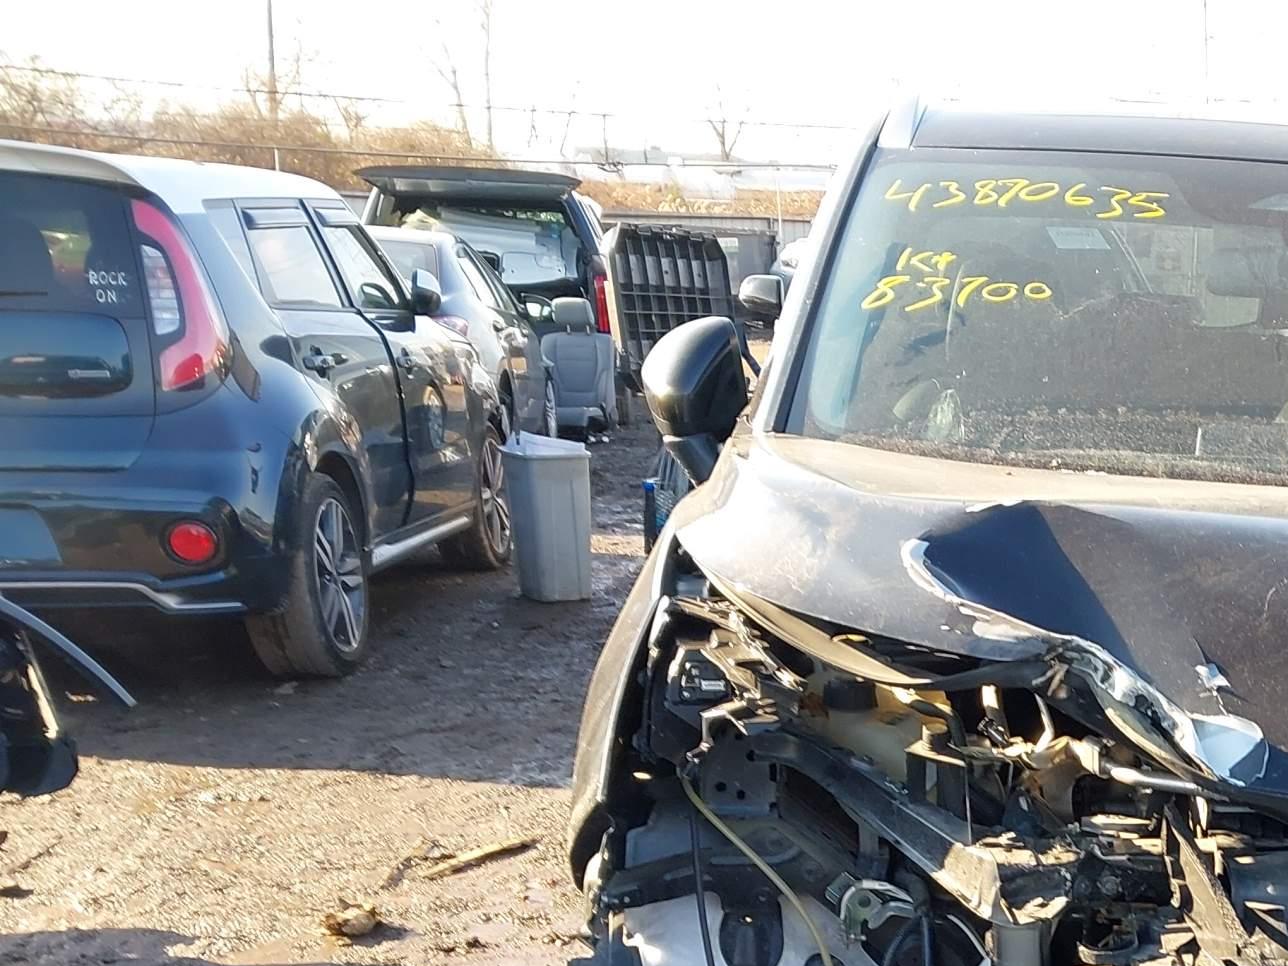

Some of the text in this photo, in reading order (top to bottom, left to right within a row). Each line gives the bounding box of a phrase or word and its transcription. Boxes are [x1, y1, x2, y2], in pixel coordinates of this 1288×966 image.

[884, 178, 1170, 219] 43870635
[88, 269, 128, 286] ROCK
[96, 288, 118, 304] ON
[860, 274, 1053, 312] 83700
